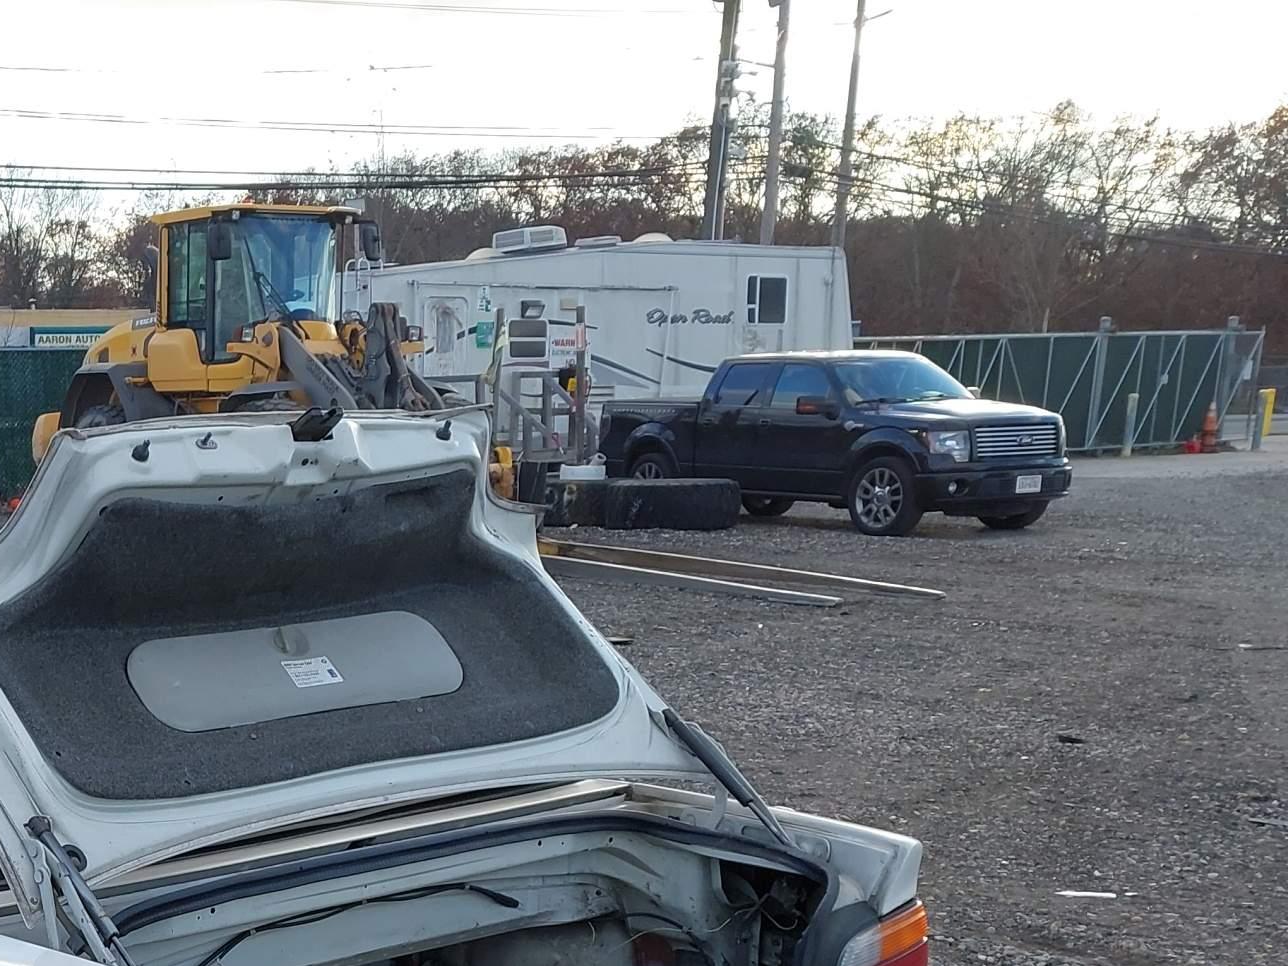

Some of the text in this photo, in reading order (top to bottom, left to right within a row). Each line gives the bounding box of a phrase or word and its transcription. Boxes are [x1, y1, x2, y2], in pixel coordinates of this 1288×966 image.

[646, 308, 735, 327] Open Road
[37, 334, 72, 345] AARON
